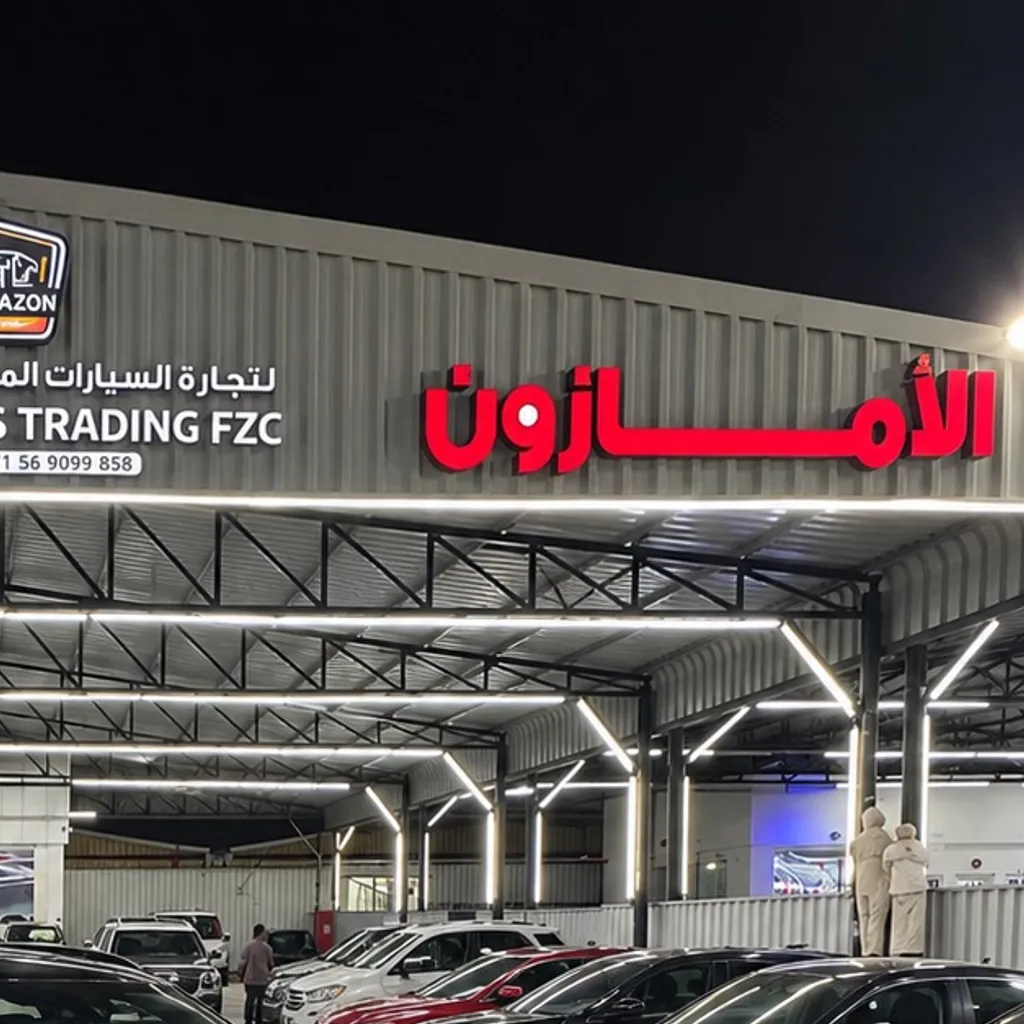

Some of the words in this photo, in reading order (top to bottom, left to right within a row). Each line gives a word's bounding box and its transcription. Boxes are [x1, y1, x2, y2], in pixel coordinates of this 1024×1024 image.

[45, 362, 172, 395] السيارات
[178, 365, 276, 399] لتجارة
[17, 406, 199, 444] TRADING
[212, 411, 282, 445] FZC
[19, 455, 41, 471] 56
[47, 455, 92, 471] 9099
[99, 456, 133, 472] 858
